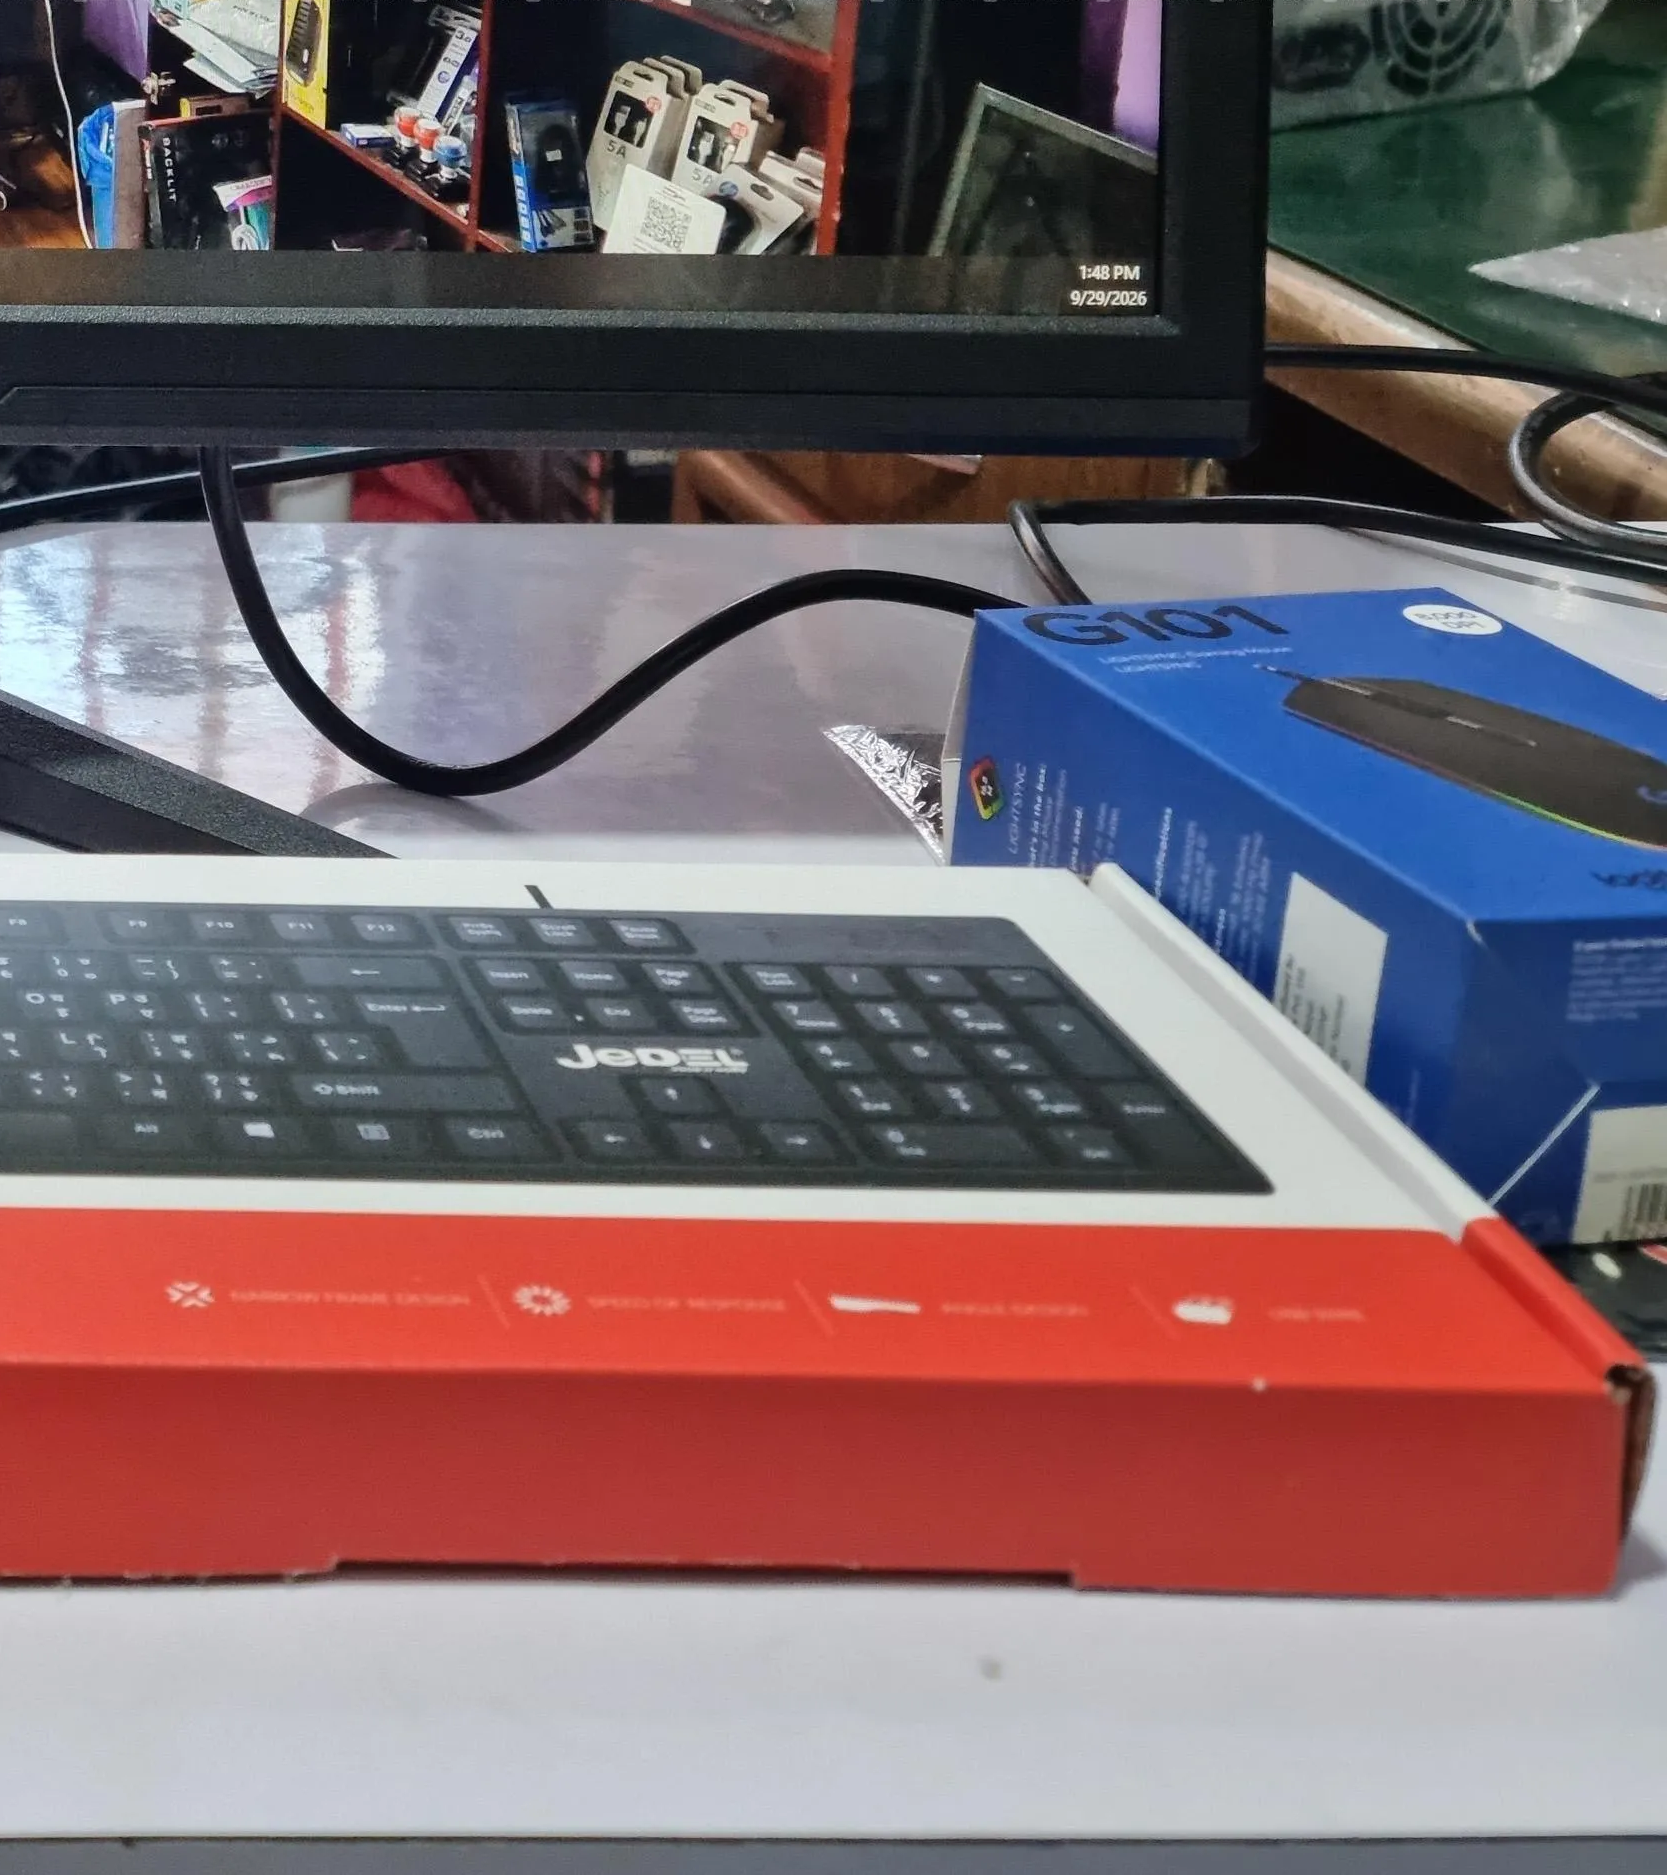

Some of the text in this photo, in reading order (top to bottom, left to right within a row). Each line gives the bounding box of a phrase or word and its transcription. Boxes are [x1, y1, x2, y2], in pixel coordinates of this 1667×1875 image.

[1078, 265, 1140, 280] 1:48 PM
[1070, 290, 1147, 307] 9/29/2026
[1022, 604, 1290, 646] G101
[1007, 761, 1029, 855] LIGHTSYNC
[108, 993, 126, 1005] P
[59, 1032, 76, 1045] L
